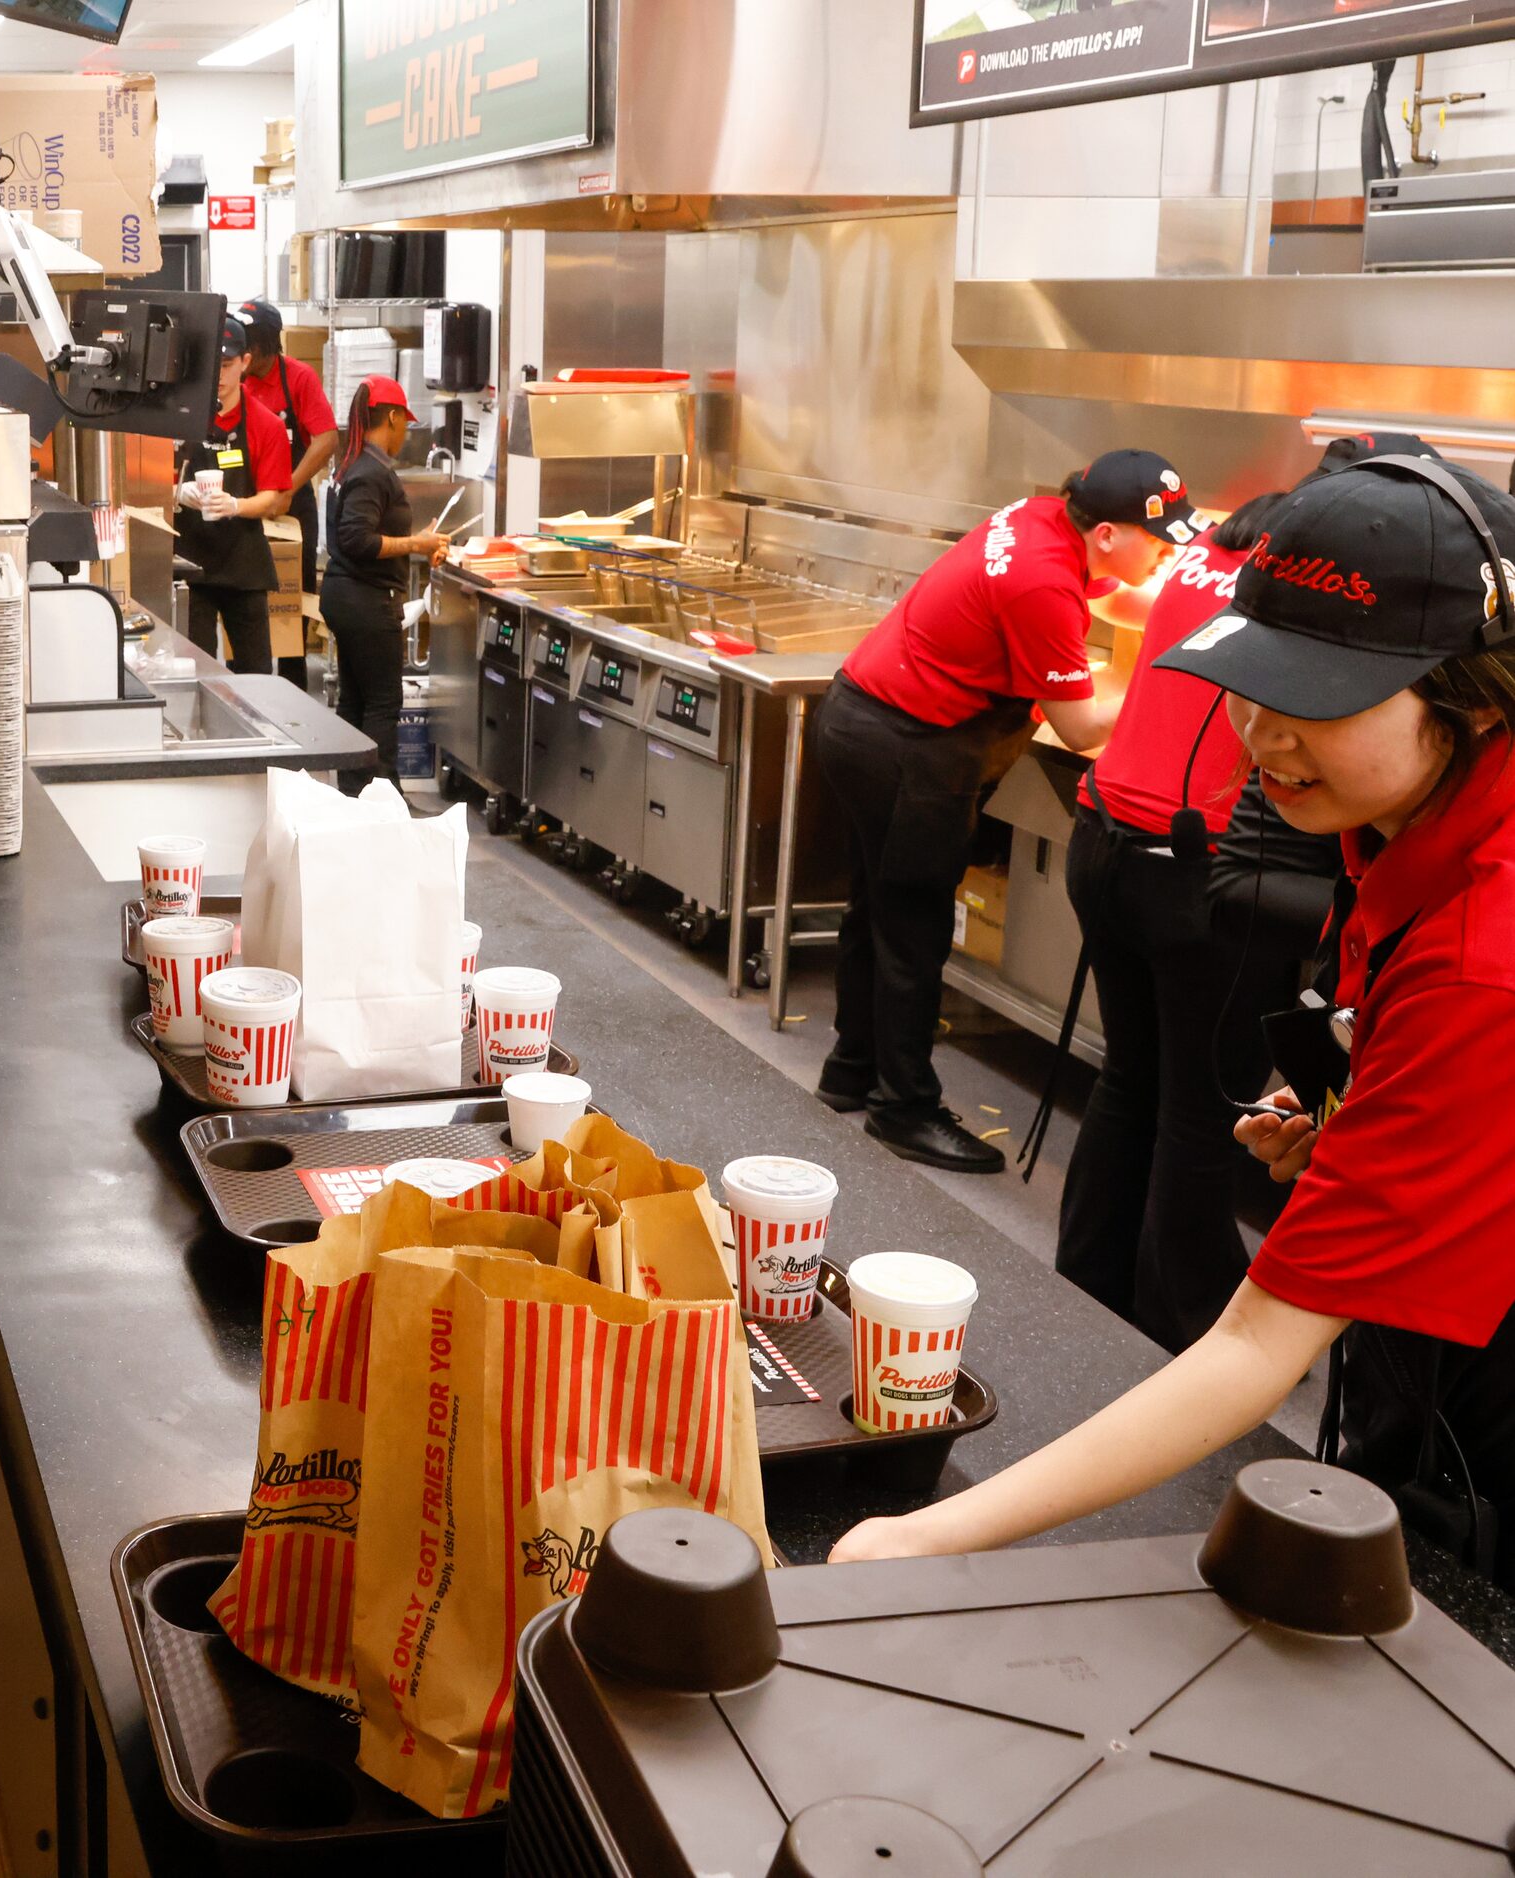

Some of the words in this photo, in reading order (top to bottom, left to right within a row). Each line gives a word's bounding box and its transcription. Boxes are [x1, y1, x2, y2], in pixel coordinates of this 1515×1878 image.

[980, 50, 1029, 73] DOWNLOAD
[1031, 44, 1049, 63] THE
[1050, 31, 1113, 61] PORTILLO'S
[1113, 25, 1144, 50] APP!
[403, 34, 484, 150] CAKE
[42, 134, 64, 211] WinCup
[8, 185, 16, 211] COL
[19, 185, 27, 202] OR
[30, 185, 38, 209] HOT
[122, 214, 140, 264] C2022
[204, 1041, 240, 1061] rtillo's
[489, 1040, 549, 1057] Portillo's
[781, 1271, 800, 1283] HOT
[783, 1253, 822, 1273] Portillo
[430, 1308, 453, 1372] YOU!
[879, 1366, 958, 1390] Portillo's
[894, 1391, 909, 1399] DOGS
[428, 1381, 450, 1438] FOR
[447, 1395, 460, 1529] portillos.com/careers
[256, 1483, 293, 1502] HOT
[297, 1480, 348, 1497] DOGS
[422, 1443, 446, 1526] FRIES
[417, 1530, 440, 1587] GOT
[445, 1530, 455, 1558] visit
[436, 1561, 455, 1599] apply,
[429, 1600, 441, 1614] To
[393, 1592, 425, 1668] ONLY
[416, 1616, 435, 1660] hiring!
[410, 1660, 422, 1698] We're
